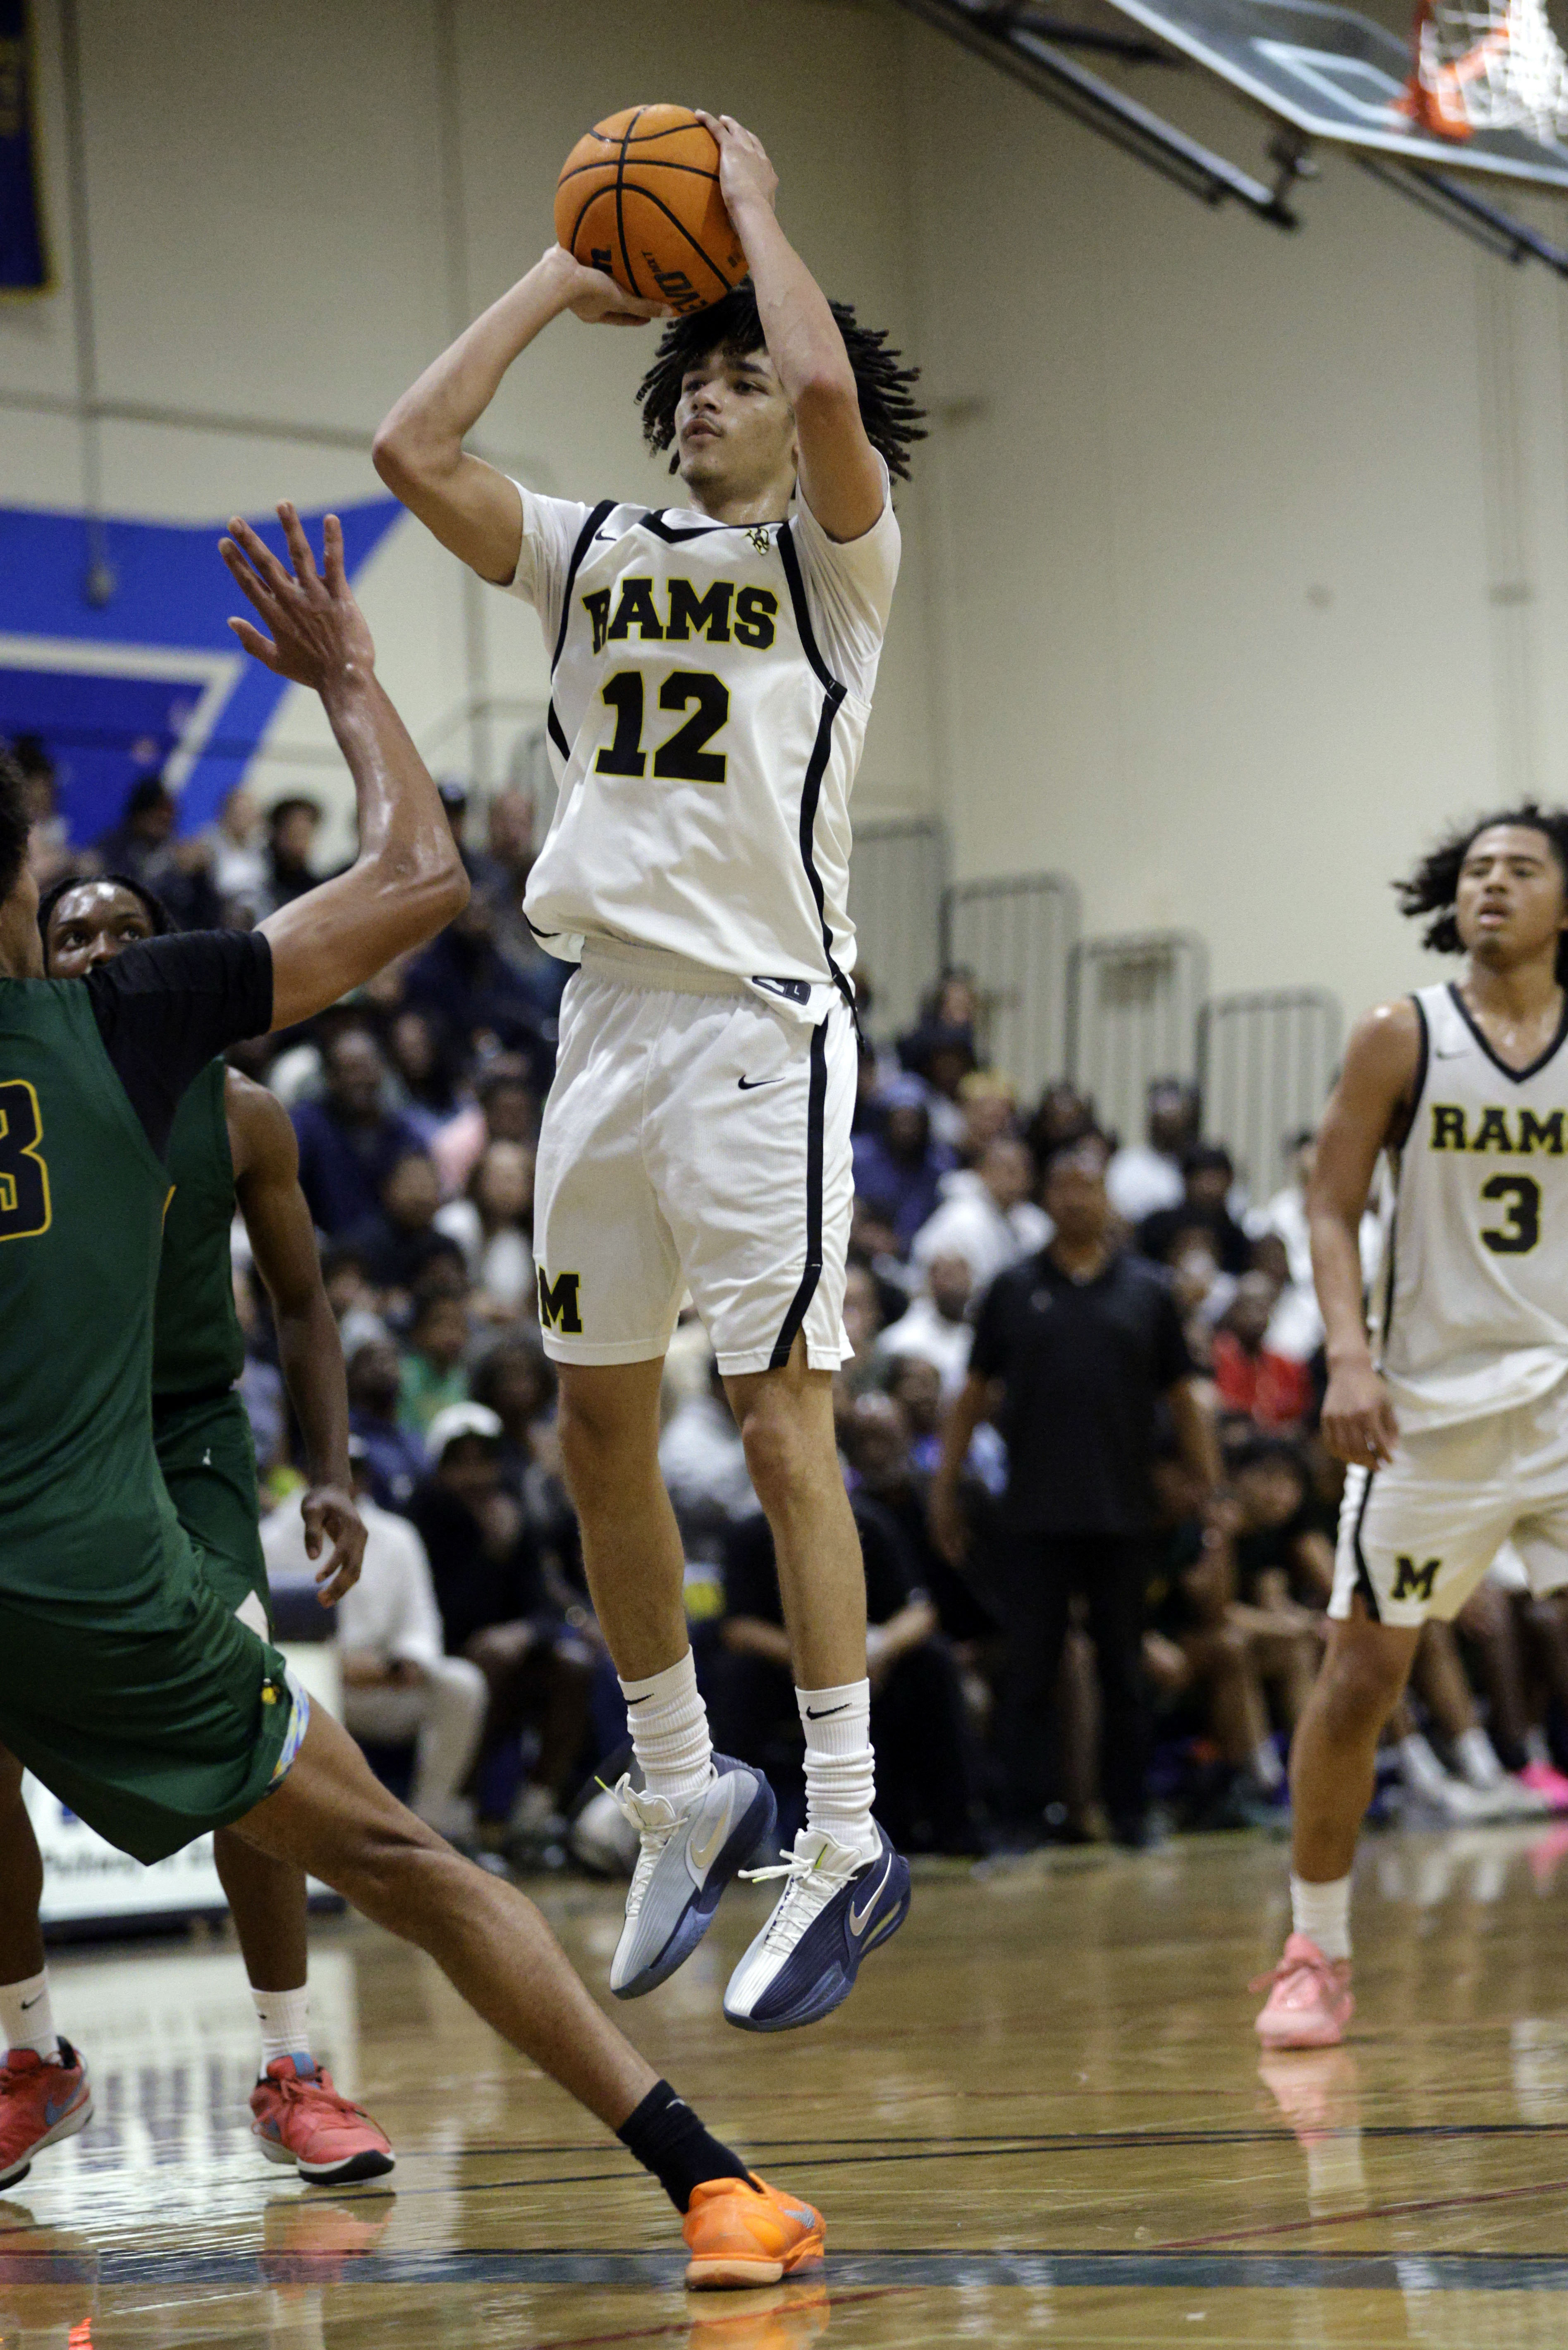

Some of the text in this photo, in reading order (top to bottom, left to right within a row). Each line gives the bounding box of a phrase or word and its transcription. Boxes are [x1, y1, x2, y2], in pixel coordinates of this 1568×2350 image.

[582, 576, 779, 655] RAMS
[595, 669, 730, 783] 12
[1431, 1102, 1568, 1157] RAM
[1480, 1172, 1541, 1256] 3
[538, 1265, 583, 1334] M
[1391, 1553, 1442, 1602] M
